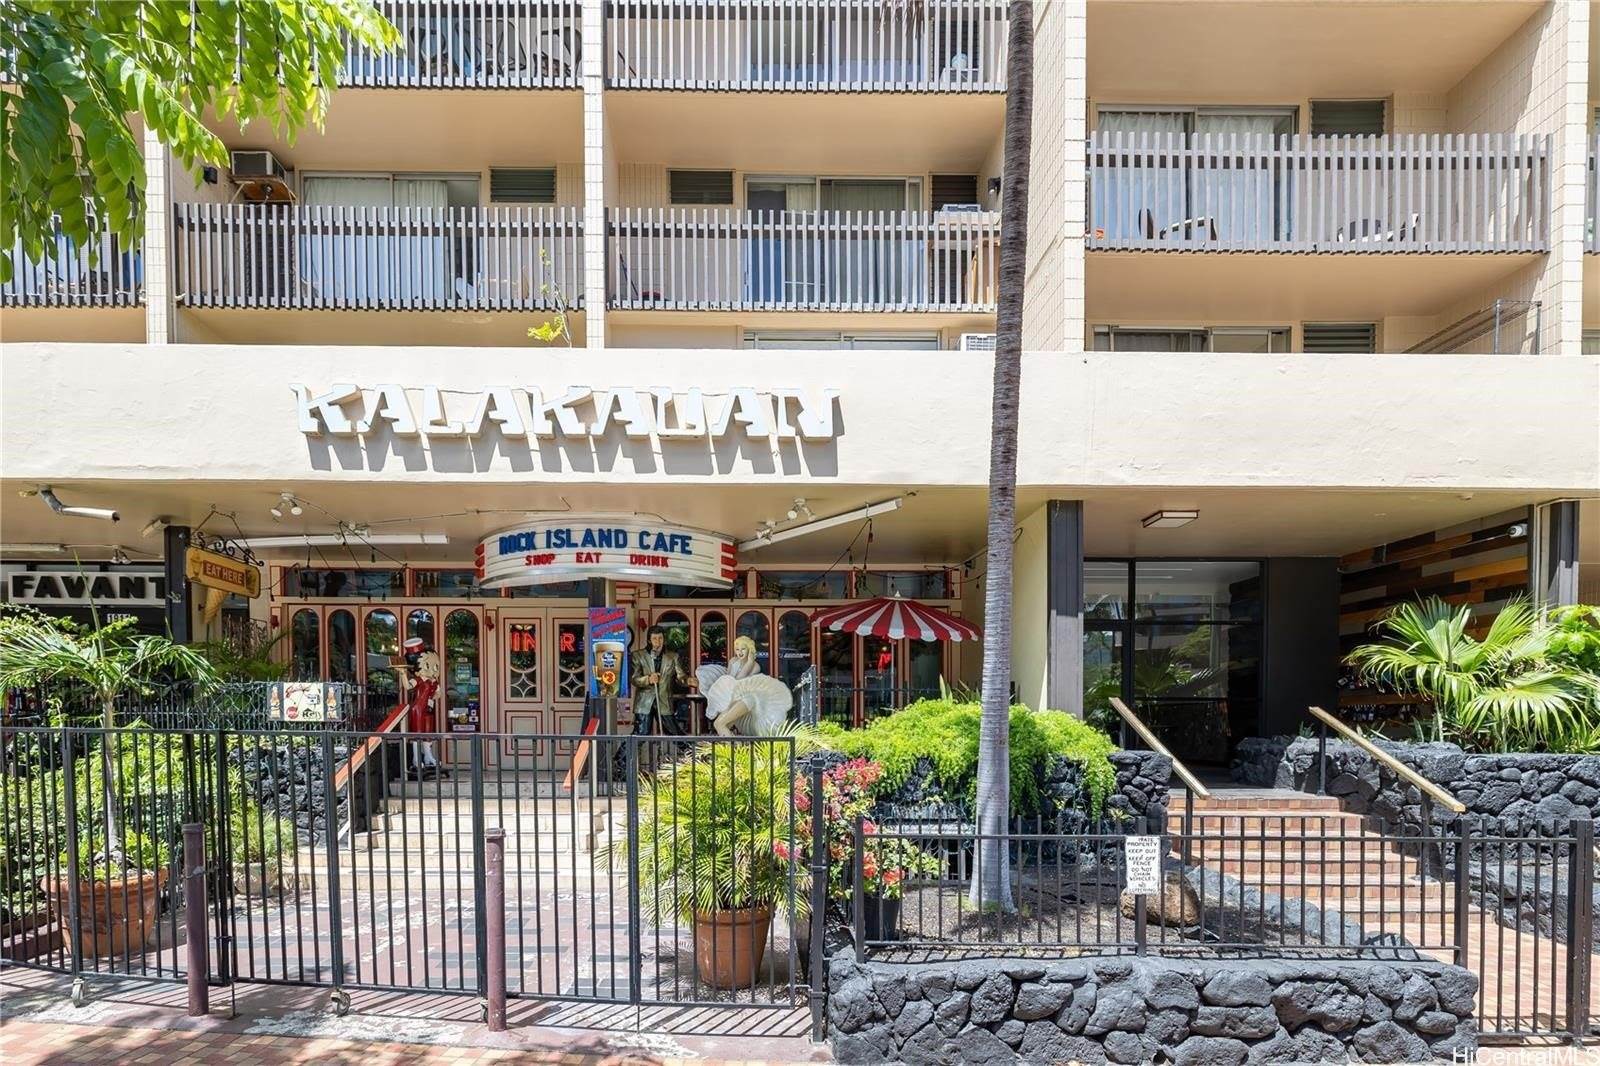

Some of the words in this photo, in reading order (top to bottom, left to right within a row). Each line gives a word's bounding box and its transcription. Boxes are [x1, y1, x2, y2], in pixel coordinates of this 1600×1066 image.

[290, 383, 840, 440] KALAKAUAN
[499, 531, 537, 555] ROCK
[545, 528, 628, 549] ISLAND
[639, 530, 692, 555] CAFE
[525, 553, 555, 566] SHOP
[575, 552, 602, 564] EAT
[630, 553, 669, 568] DRINK
[206, 563, 221, 577] EAT
[222, 567, 243, 585] HERE
